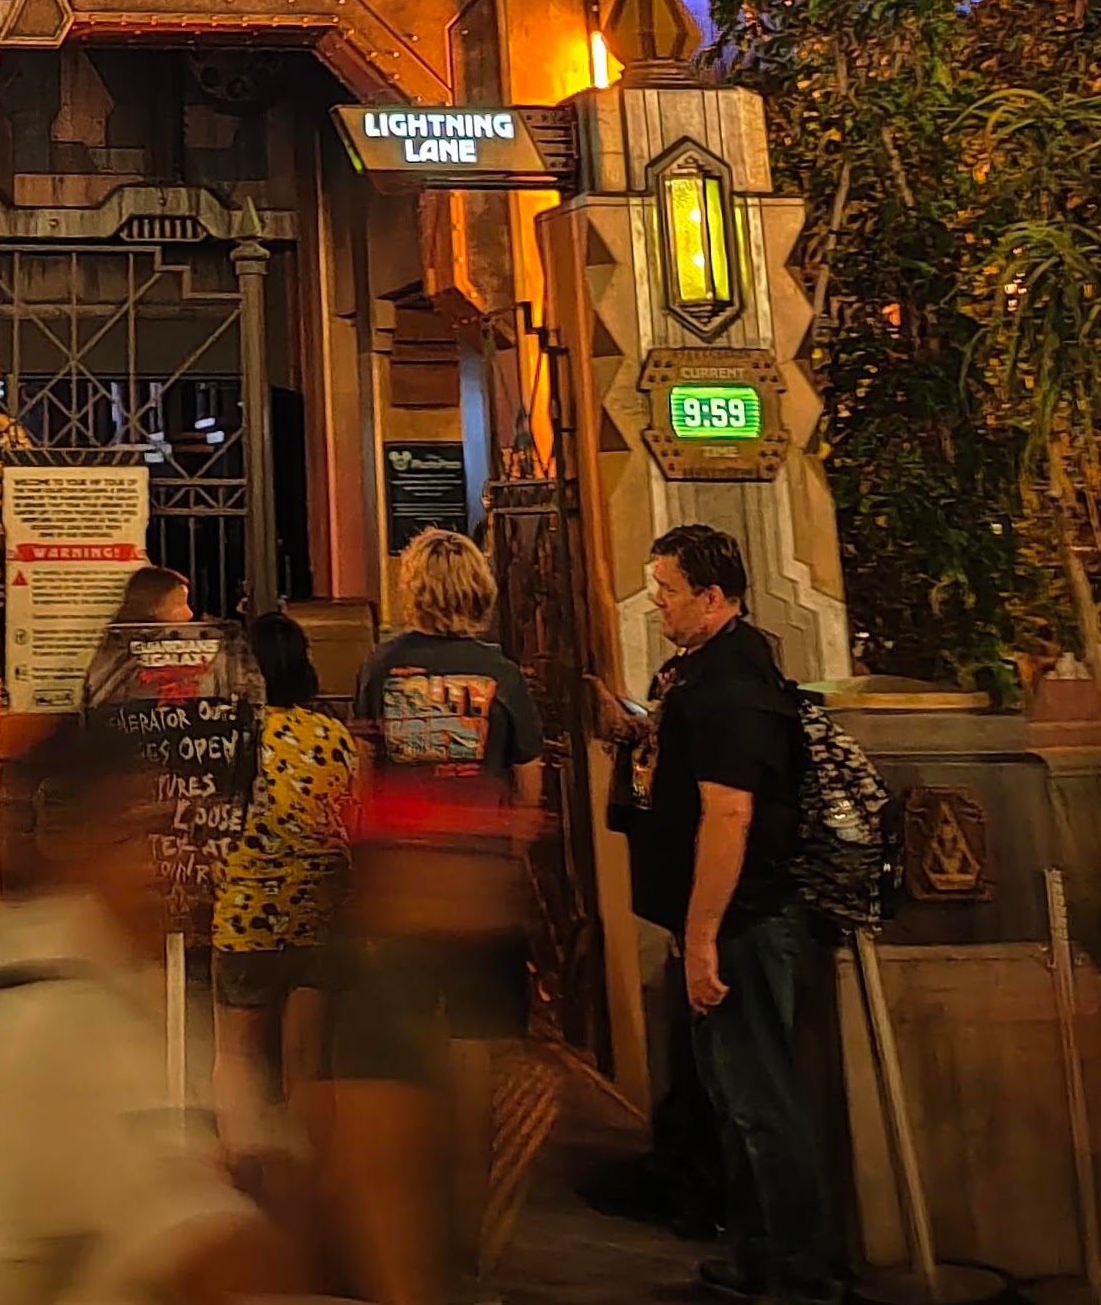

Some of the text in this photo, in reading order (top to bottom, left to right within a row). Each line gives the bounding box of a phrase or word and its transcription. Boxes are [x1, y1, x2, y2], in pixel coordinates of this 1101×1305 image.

[364, 112, 515, 139] LIGHTNING
[405, 139, 477, 163] LANE
[681, 367, 745, 379] CURRENT
[683, 397, 746, 428] 9:59
[702, 445, 739, 458] TIME
[33, 547, 120, 558] WARNING!
